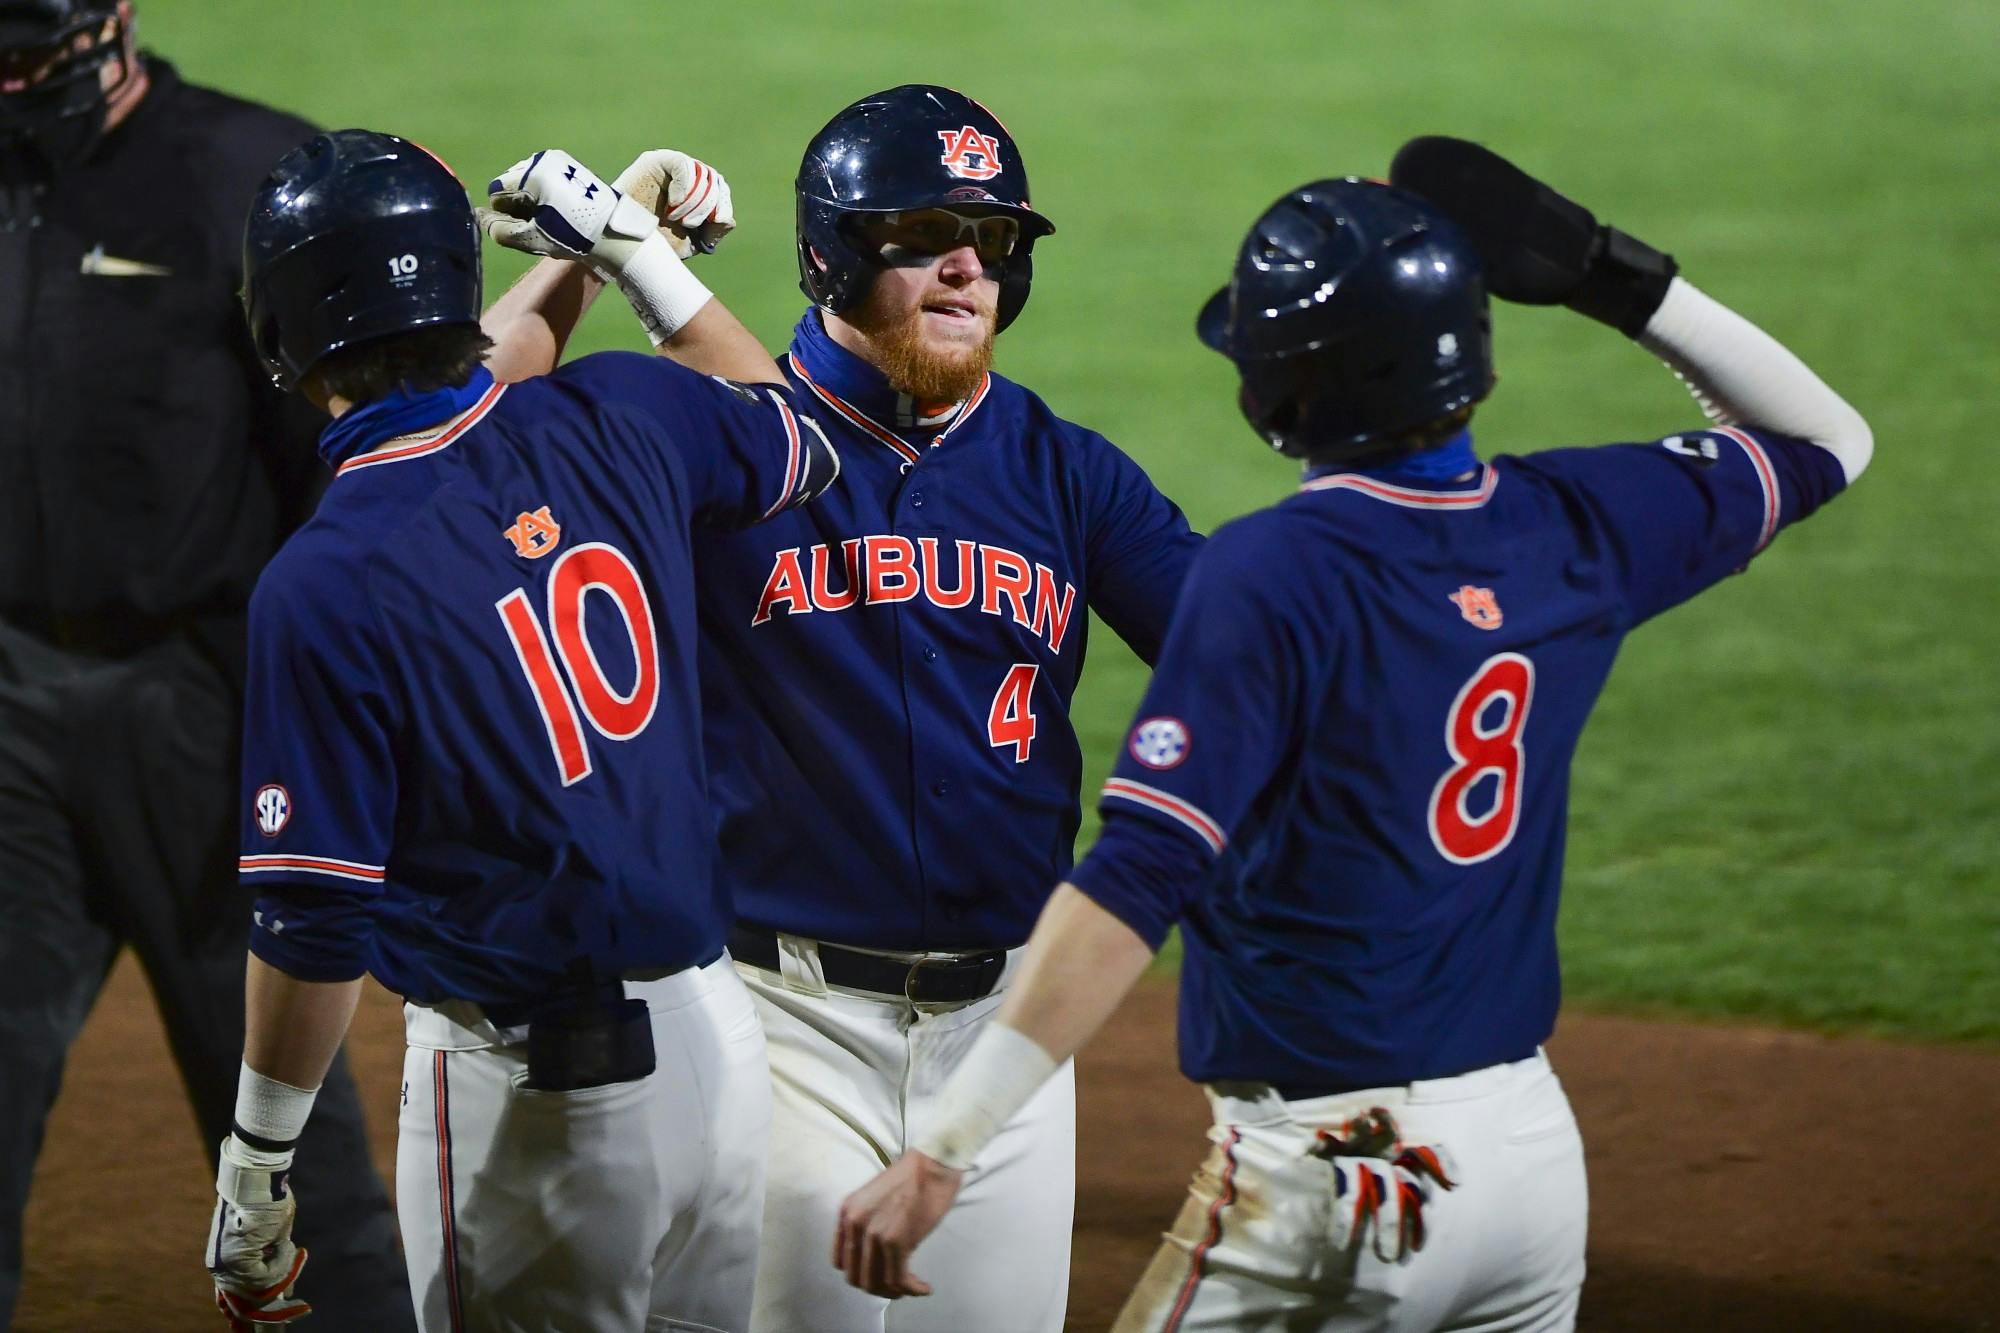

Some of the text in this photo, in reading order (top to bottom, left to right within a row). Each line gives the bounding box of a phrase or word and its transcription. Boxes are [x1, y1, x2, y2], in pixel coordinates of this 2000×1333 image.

[388, 254, 418, 276] 10
[752, 535, 1076, 655] AUBURN
[495, 541, 660, 788] 10
[988, 663, 1039, 763] 4
[256, 788, 288, 833] SEC
[1427, 651, 1536, 866] 8
